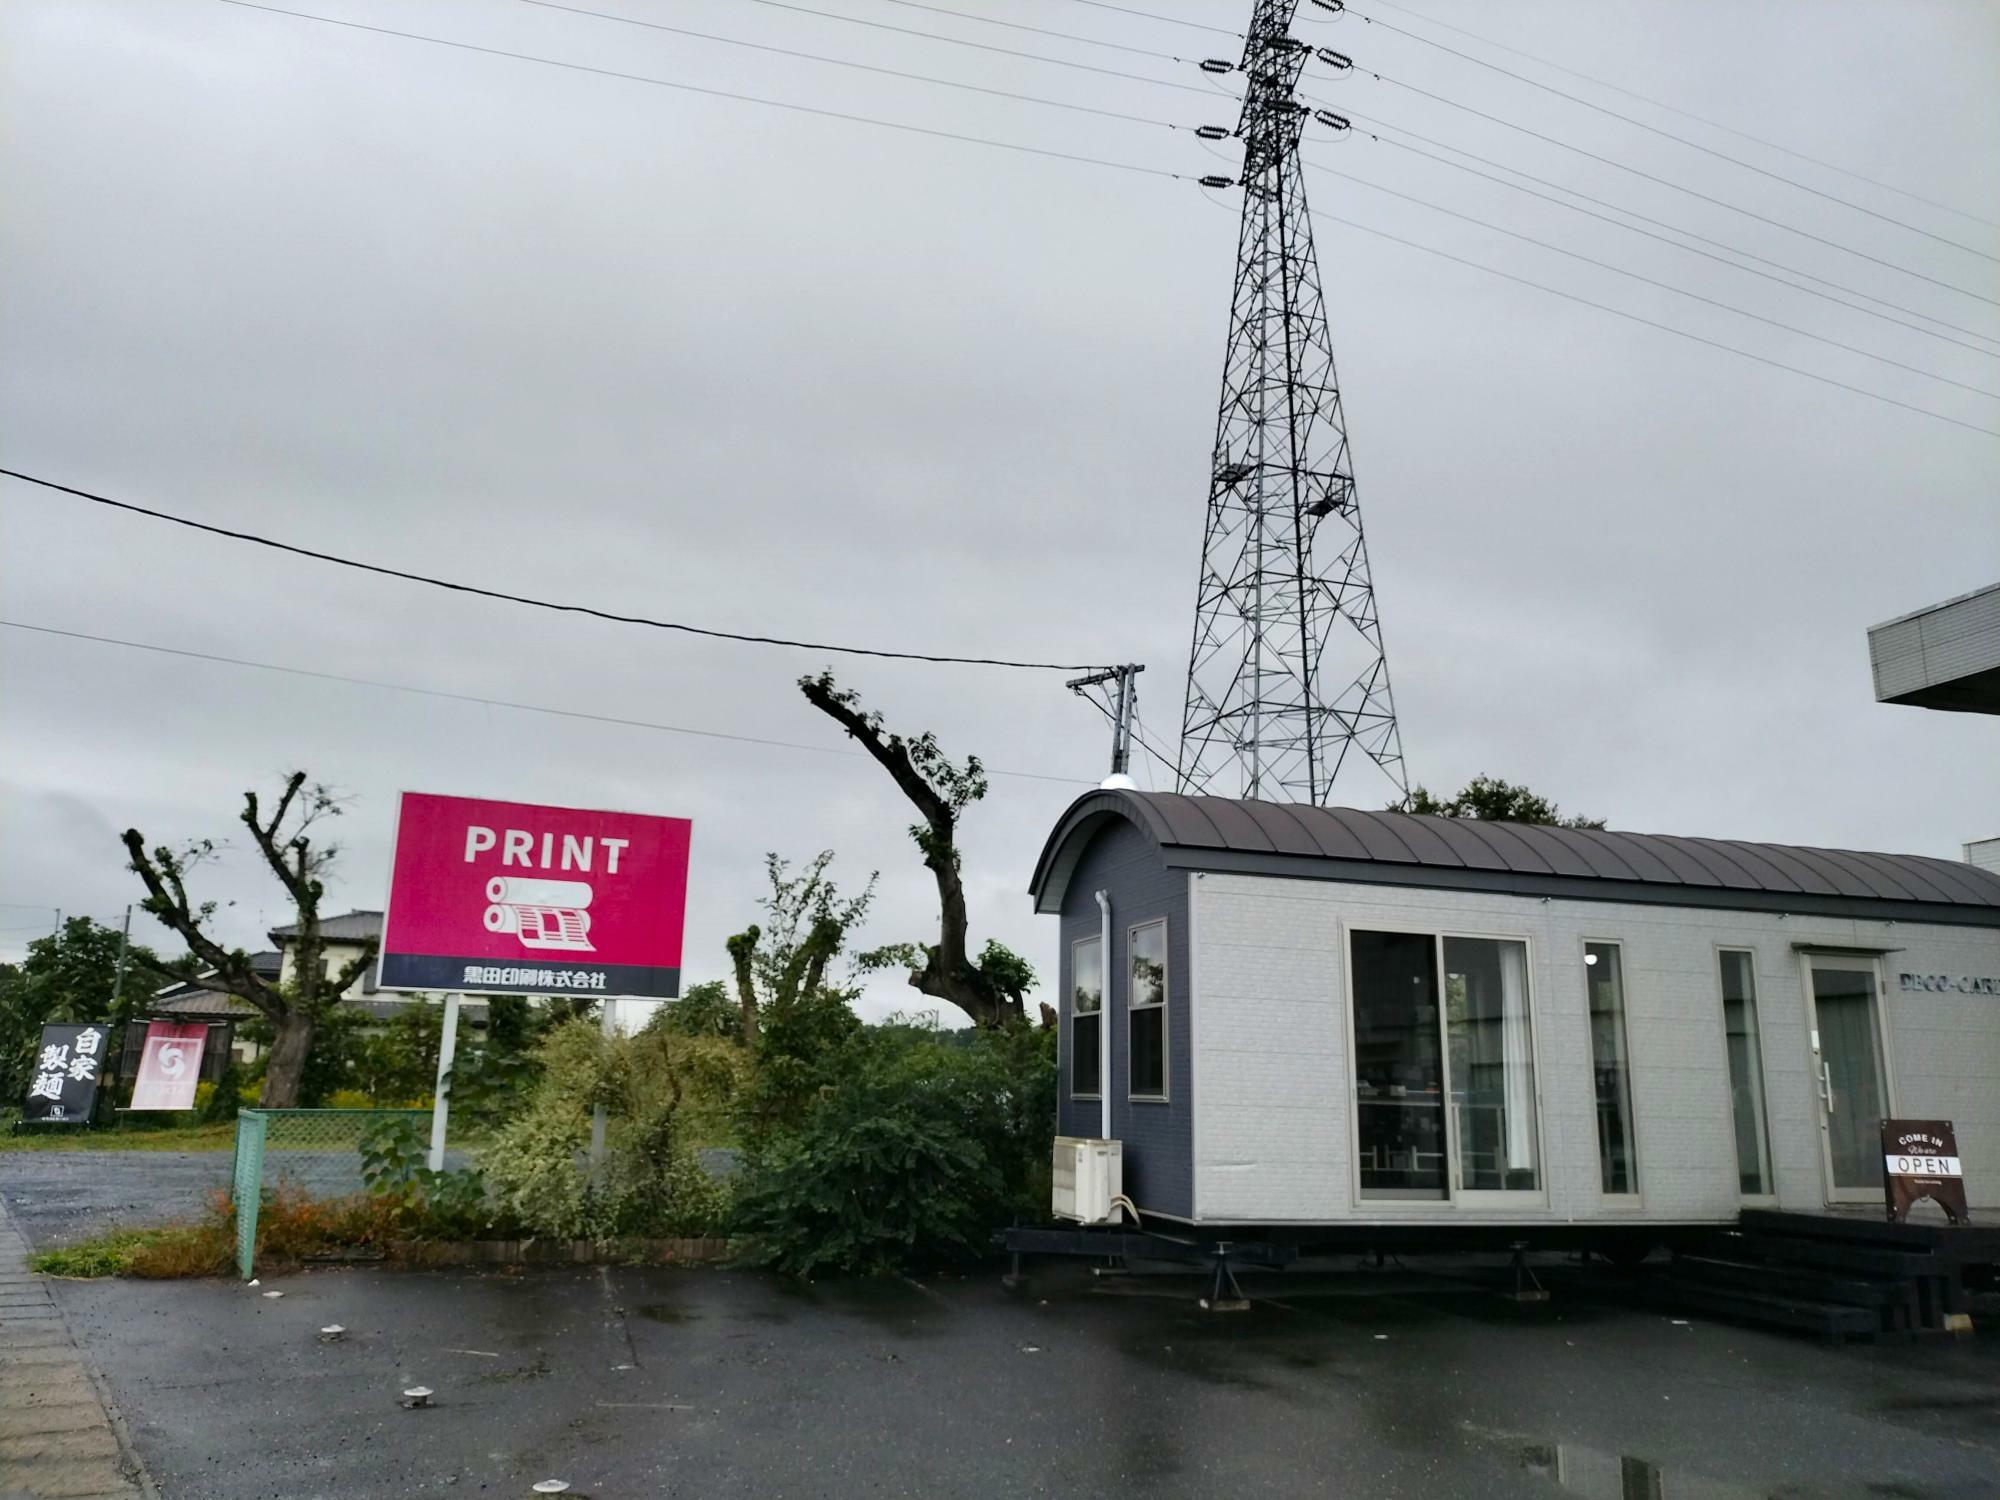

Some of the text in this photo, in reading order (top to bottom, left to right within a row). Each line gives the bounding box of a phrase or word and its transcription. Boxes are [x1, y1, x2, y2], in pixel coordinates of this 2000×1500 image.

[464, 826, 630, 875] PRINT
[463, 965, 607, 989] 黒田印刷株式会社
[67, 1026, 101, 1081] 自家
[29, 1044, 69, 1100] 製麺
[1898, 1133, 1943, 1148] COME IN
[1898, 1157, 1950, 1174] OPEN
